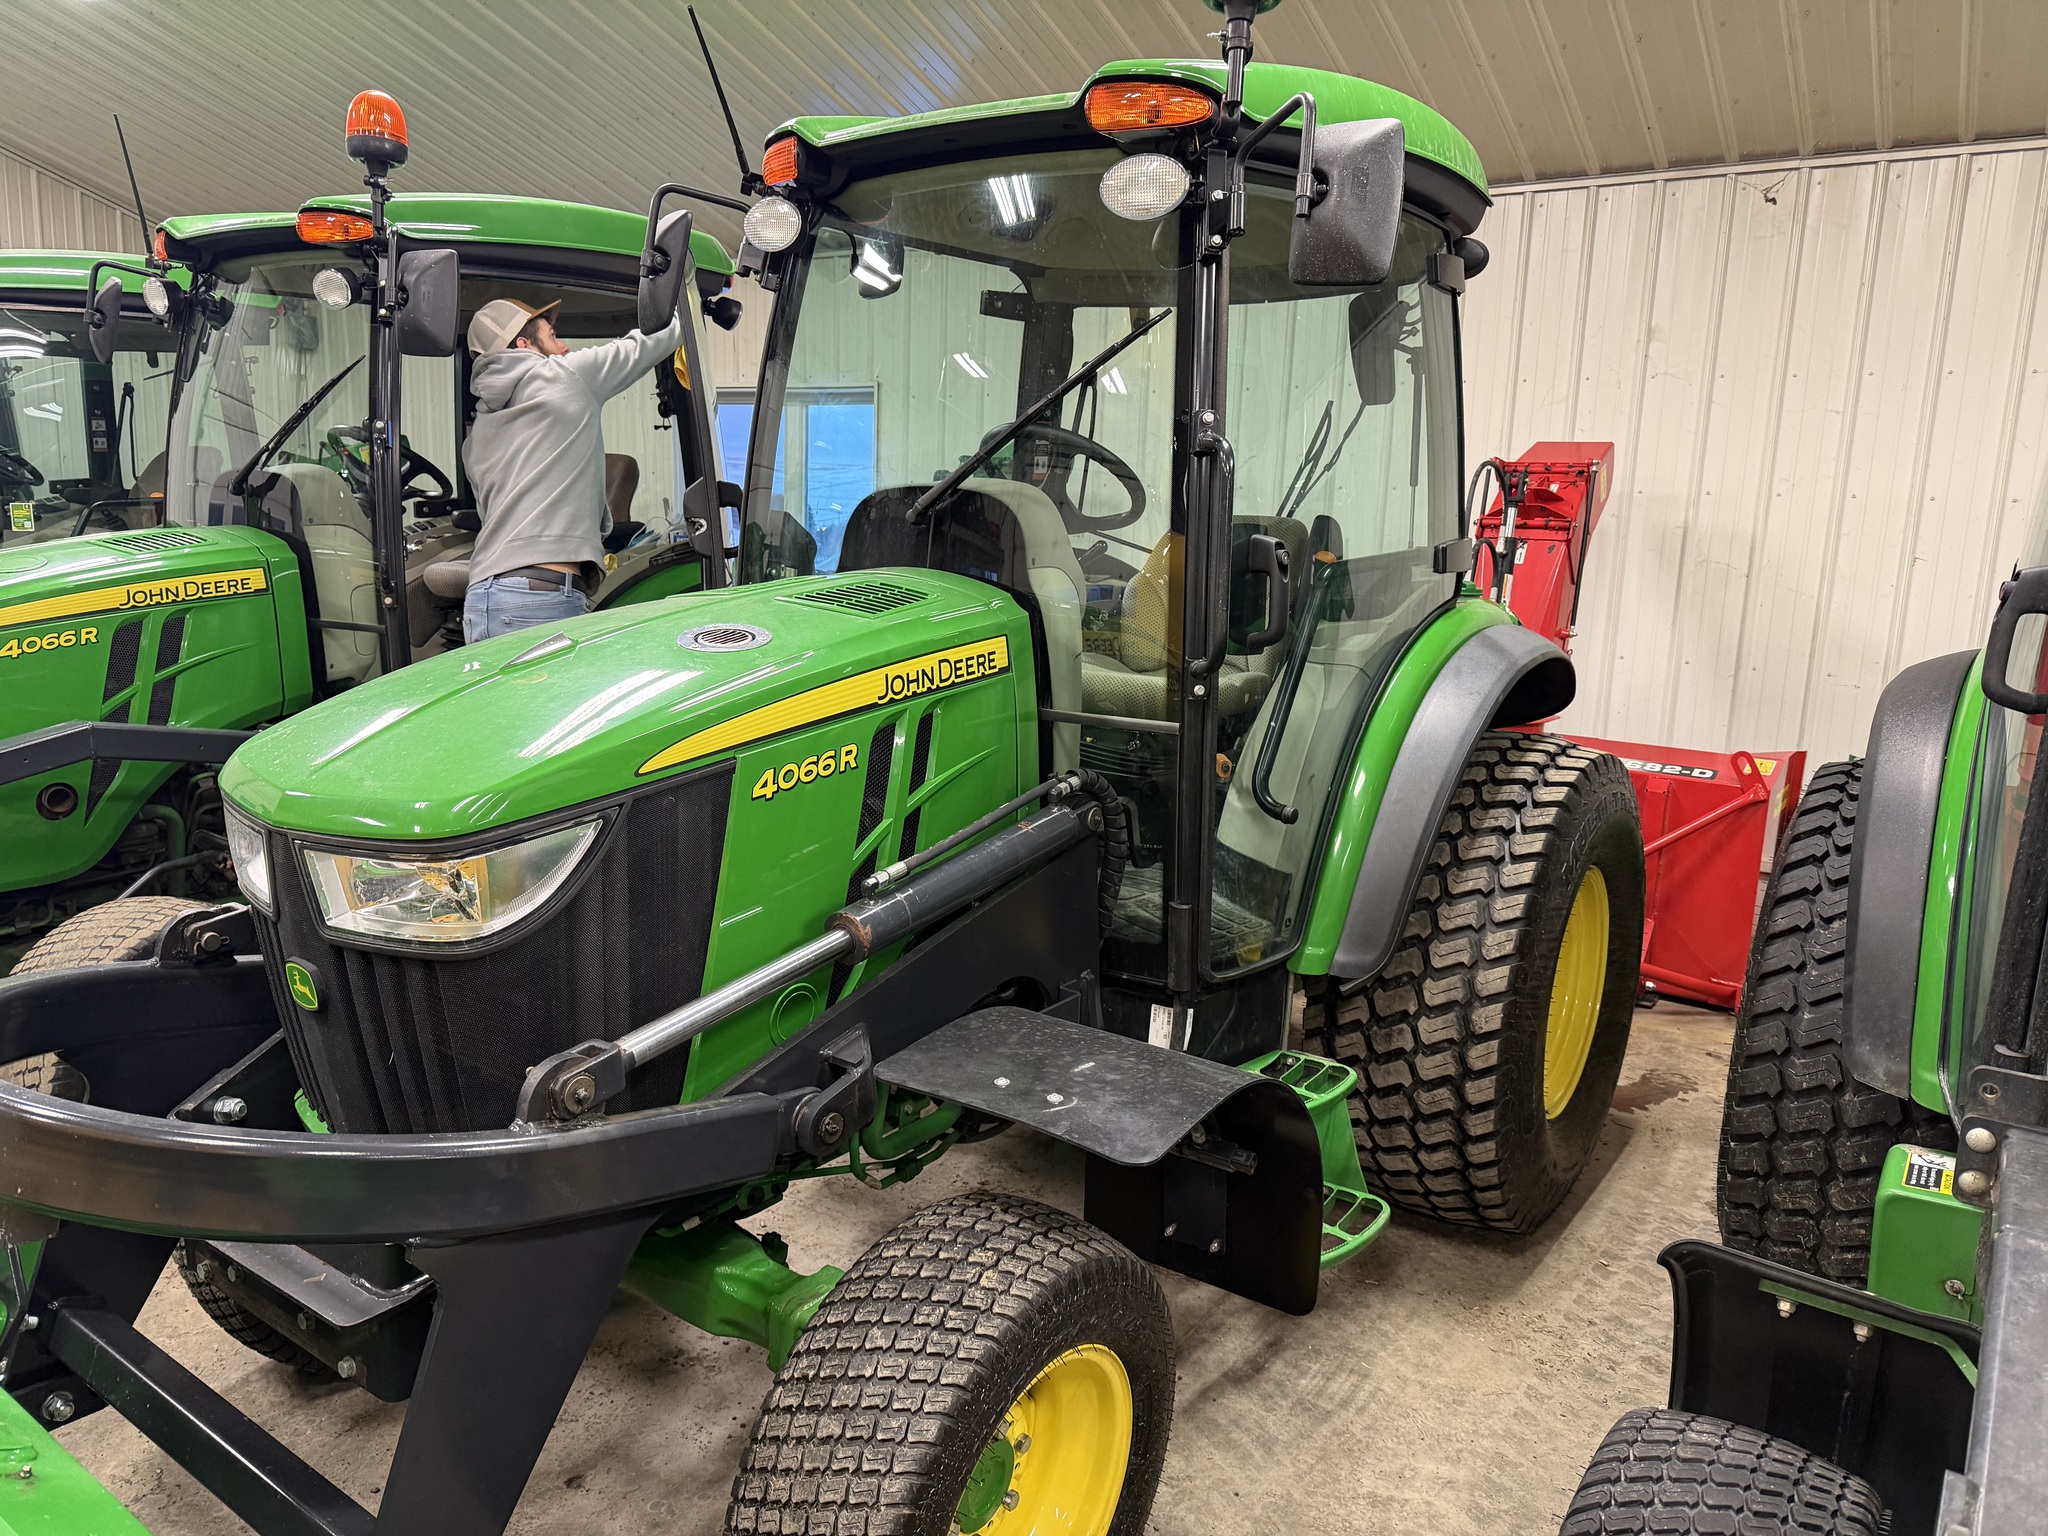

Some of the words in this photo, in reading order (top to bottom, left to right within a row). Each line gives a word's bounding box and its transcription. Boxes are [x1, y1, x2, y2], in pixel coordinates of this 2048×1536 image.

[119, 586, 180, 608] JOHN
[185, 578, 252, 598] DEERE
[878, 666, 934, 701] JOHN
[938, 651, 997, 684] DEERE
